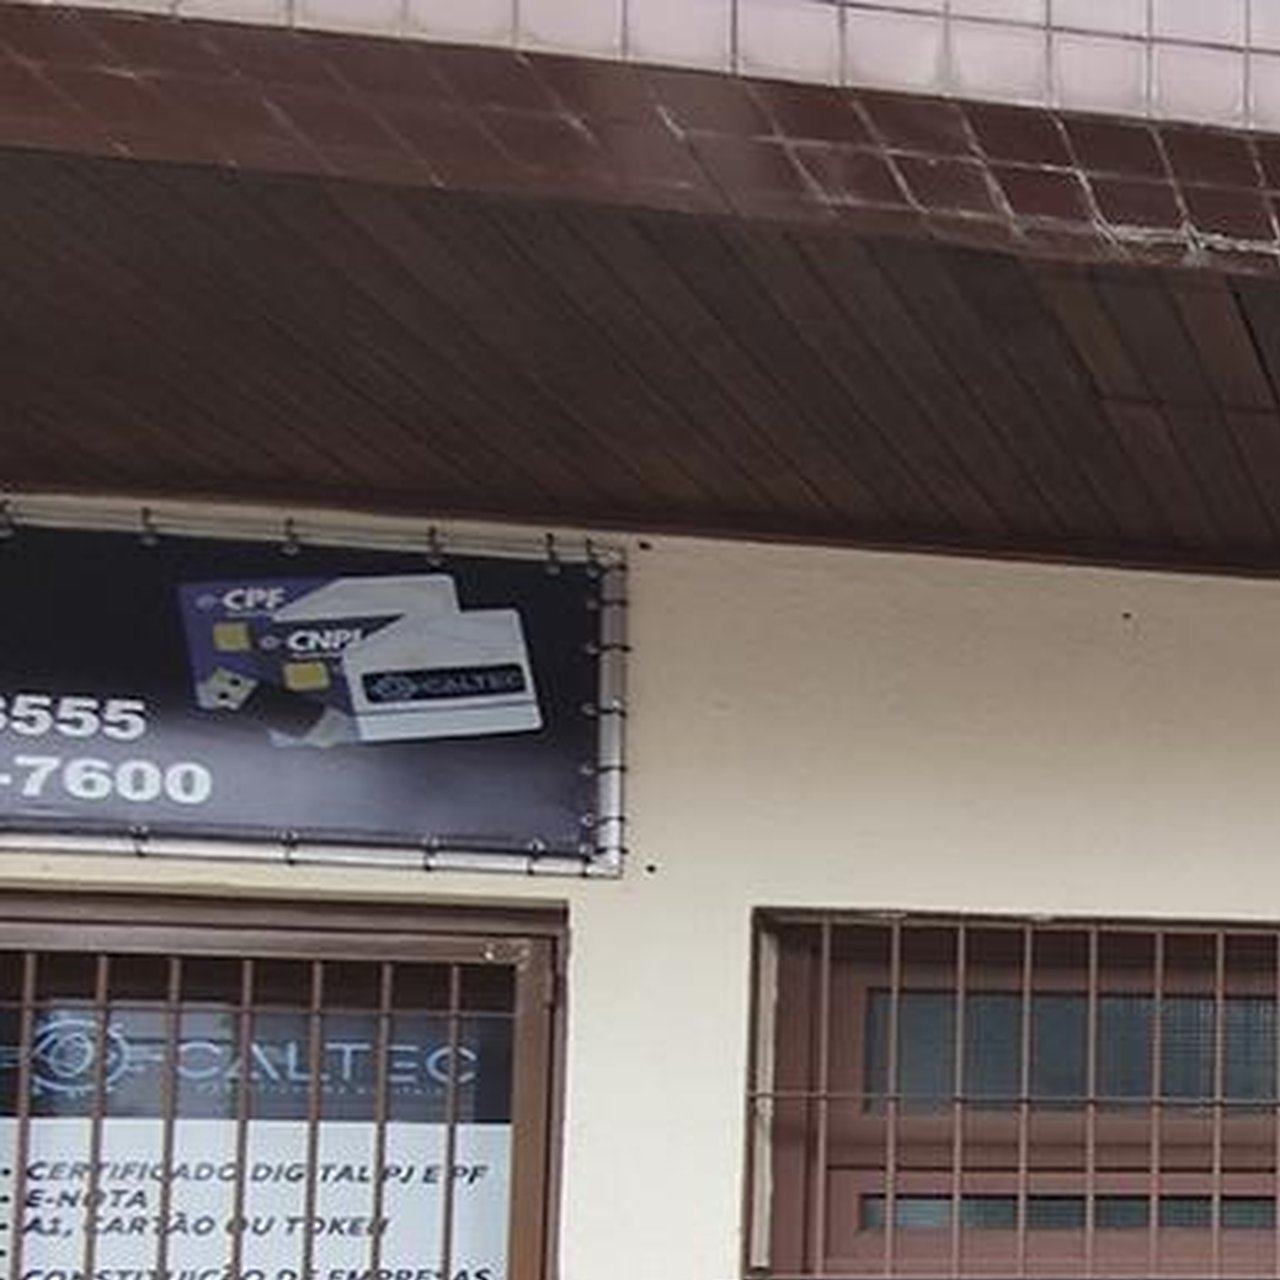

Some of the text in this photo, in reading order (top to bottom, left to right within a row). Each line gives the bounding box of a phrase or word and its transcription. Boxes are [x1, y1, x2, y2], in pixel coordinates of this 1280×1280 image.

[222, 588, 288, 609] CPF
[0, 693, 147, 742] 555
[178, 1040, 477, 1083] CALTEC
[26, 1161, 489, 1185] CERTIFICADO DIGTAL PJ E PF
